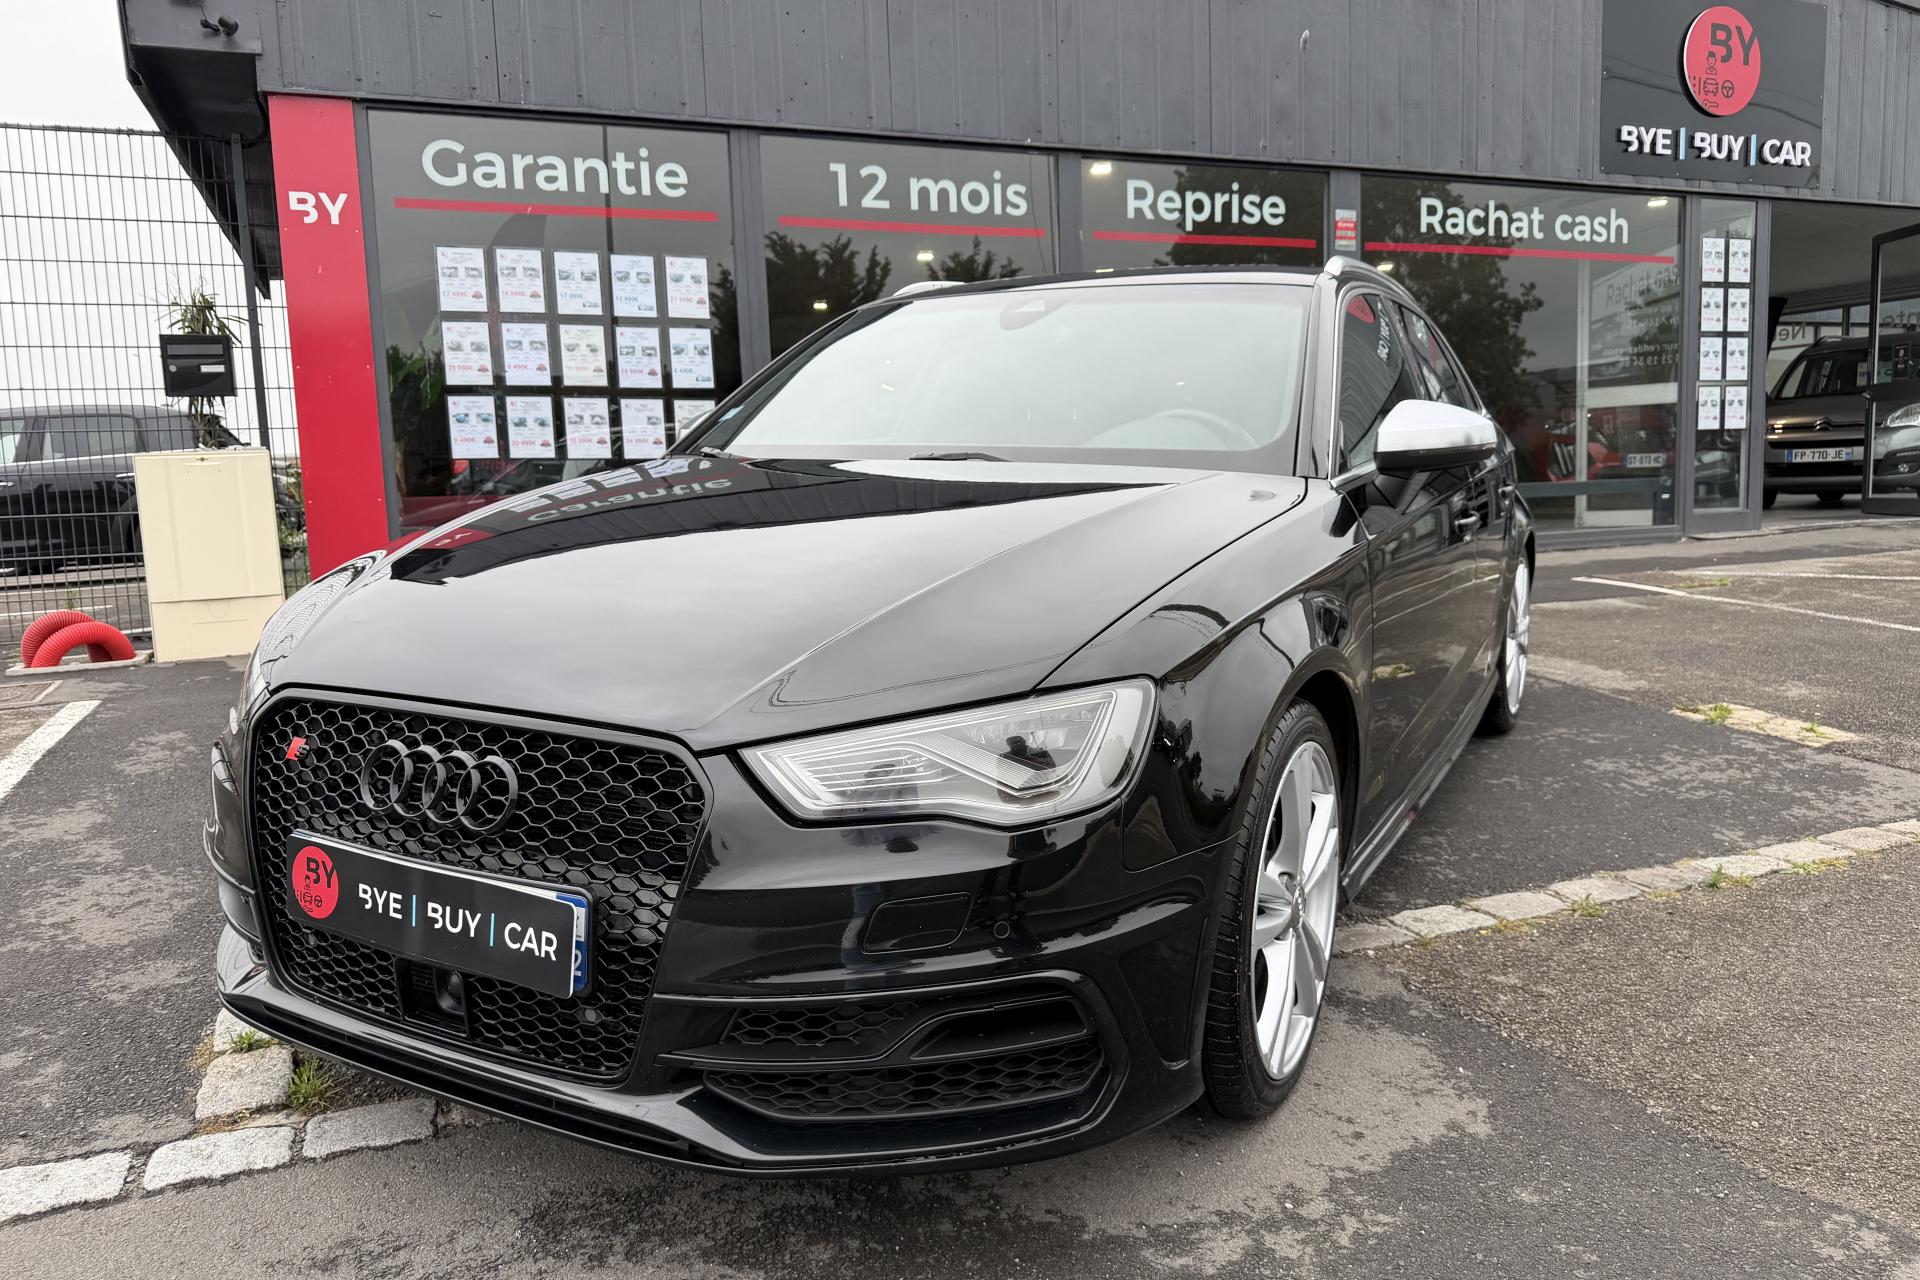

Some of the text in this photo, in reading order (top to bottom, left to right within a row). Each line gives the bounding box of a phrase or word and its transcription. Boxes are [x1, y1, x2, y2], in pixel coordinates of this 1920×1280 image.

[1710, 22, 1757, 66] BY
[421, 138, 689, 198] Garantie
[1620, 125, 1811, 167] BYE BUY CAR
[288, 191, 348, 225] BY
[829, 162, 1028, 217] 12 mois
[1125, 179, 1286, 232] Reprise
[1419, 197, 1629, 244] Rachat cash
[305, 855, 338, 890] BY
[359, 883, 557, 962] BYE BUY CAR
